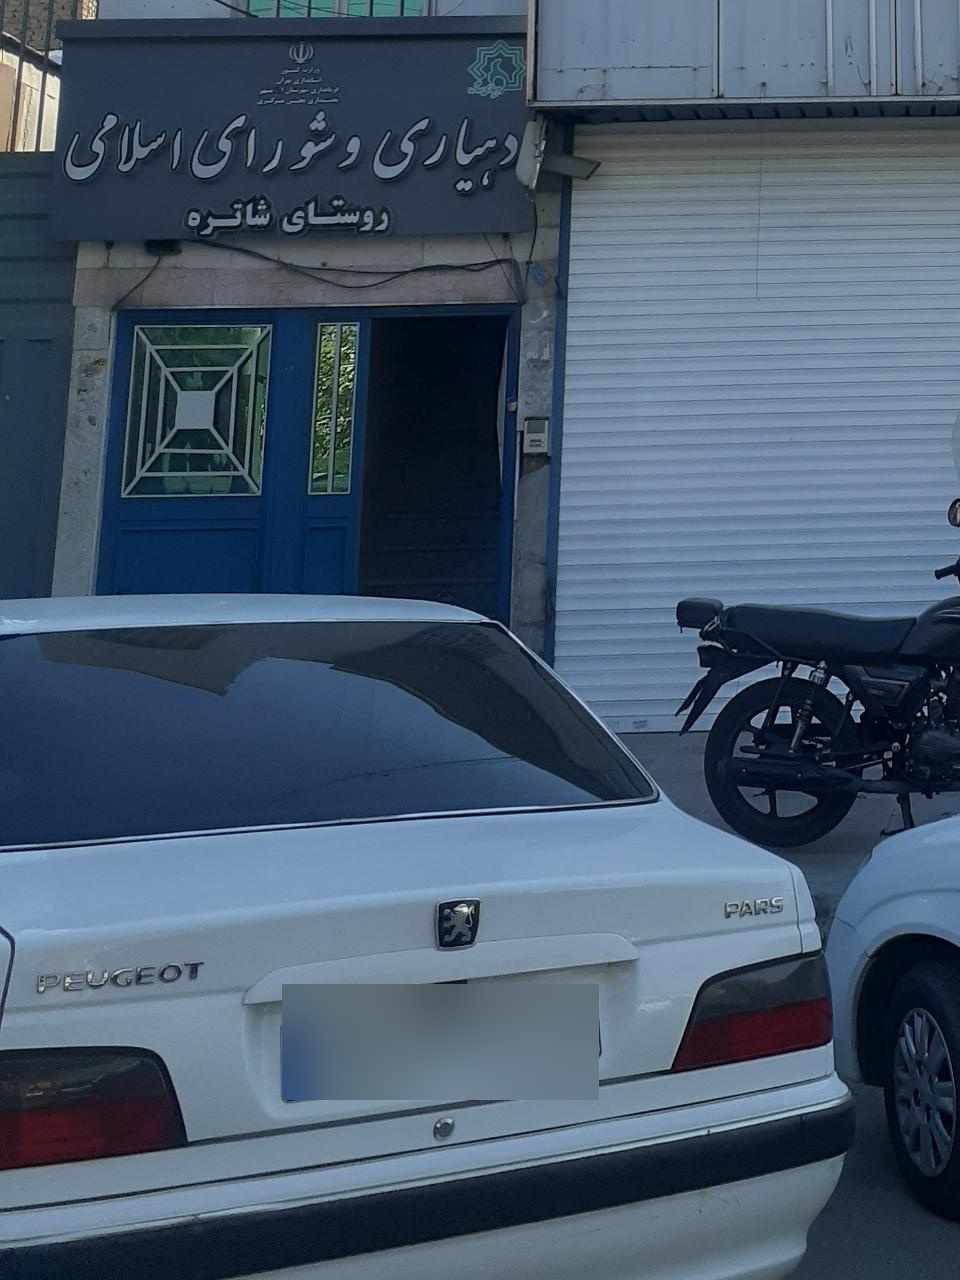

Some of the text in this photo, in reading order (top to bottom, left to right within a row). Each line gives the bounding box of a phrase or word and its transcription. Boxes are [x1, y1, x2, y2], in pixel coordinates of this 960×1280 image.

[64, 110, 519, 191] دهیاری و شورای اسلامی
[187, 196, 390, 235] روستای شاتره
[724, 896, 784, 919] PARS
[36, 960, 205, 994] PEUGEOT
